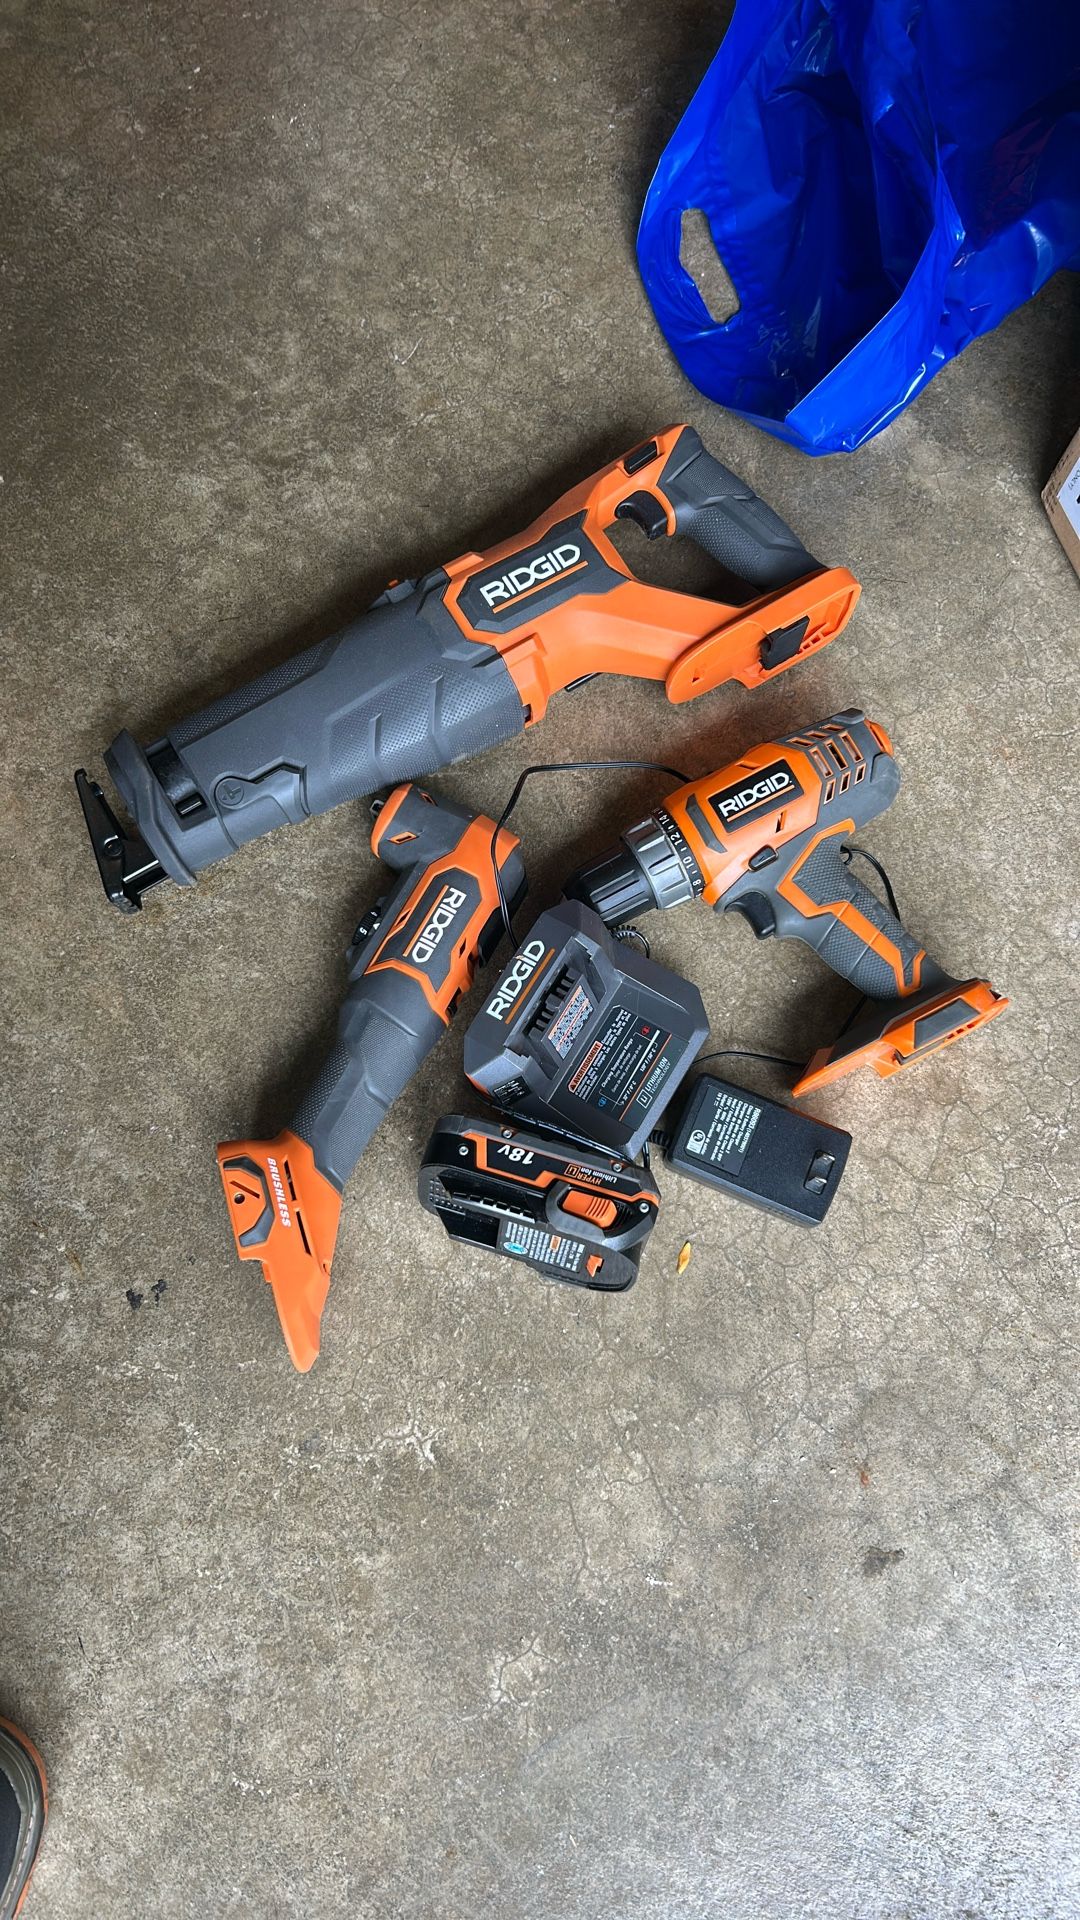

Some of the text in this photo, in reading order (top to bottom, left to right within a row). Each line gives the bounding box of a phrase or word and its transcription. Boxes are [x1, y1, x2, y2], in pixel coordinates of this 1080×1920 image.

[479, 544, 581, 607] RIDGID
[718, 772, 794, 823] RIDGID
[669, 831, 683, 845] 12
[681, 855, 695, 869] 10
[692, 878, 701, 886] 8
[358, 926, 368, 935] 5
[412, 887, 468, 963] RIDGID
[486, 940, 545, 1021] RIDGID
[572, 1042, 601, 1084] AVERTISSEMENT
[644, 1056, 668, 1091] LITHIUM ION
[267, 1157, 291, 1227] BRUSHLESS
[567, 1166, 601, 1184] HYPER Li
[581, 1166, 617, 1183] Lithium Ion
